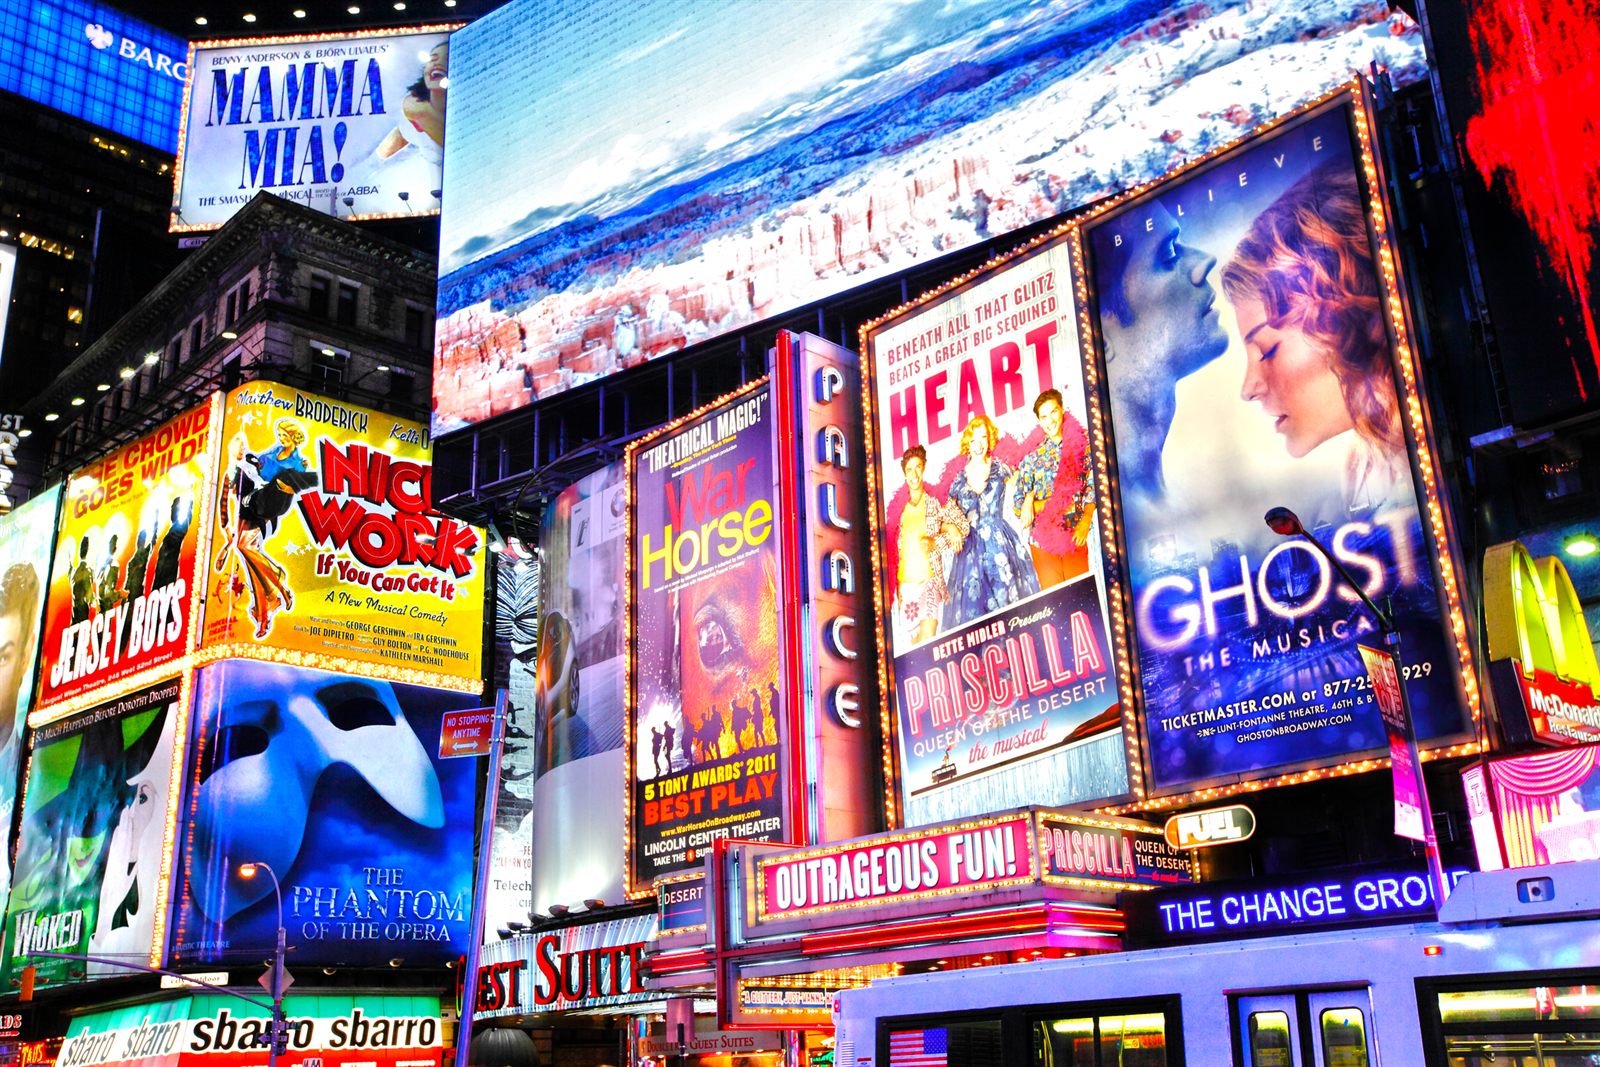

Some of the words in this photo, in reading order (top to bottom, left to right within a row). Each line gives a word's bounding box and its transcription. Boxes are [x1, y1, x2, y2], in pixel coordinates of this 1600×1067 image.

[119, 37, 188, 81] BARC
[212, 55, 242, 66] BENNY
[245, 51, 300, 64] ANDERSSON
[304, 50, 311, 59] &
[205, 58, 386, 127] MAMMA
[239, 121, 348, 189] MIA!
[199, 197, 217, 207] THE
[347, 186, 379, 196] ABBA
[1114, 136, 1323, 247] BELIEVE
[947, 312, 970, 338] ALL
[975, 295, 1008, 324] THAT
[1014, 272, 1054, 306] GLITZ
[889, 360, 921, 385] BEATS
[925, 356, 931, 370] A
[935, 337, 969, 364] GREAT
[973, 327, 993, 346] BIG
[997, 296, 1057, 335] SEQUINED
[0, 413, 24, 431] ST
[236, 390, 294, 411] Matthew
[295, 393, 369, 434] BRODERICK
[389, 423, 420, 445] Kelli
[123, 407, 211, 470] CROWD
[74, 471, 134, 519] GOES
[665, 457, 755, 532] War
[299, 490, 479, 577] WORK
[642, 499, 773, 590] Horse
[815, 366, 862, 728] PALACE
[316, 553, 334, 575] If
[337, 560, 371, 586] You
[372, 572, 405, 592] Can
[407, 574, 438, 594] Get
[441, 582, 455, 600] It
[1138, 510, 1418, 652] GHOST
[325, 591, 335, 602] A
[340, 592, 362, 607] New
[366, 596, 407, 616] Musical
[409, 606, 449, 626] Comedy
[50, 601, 130, 689] JERSEY
[128, 578, 186, 659] BOYS
[309, 627, 321, 636] JOE
[323, 629, 355, 641] DIPIETRO
[373, 637, 385, 646] GUY
[387, 639, 412, 650] BOLTON
[433, 648, 470, 661] WODEHOUSE
[346, 620, 371, 632] GEORGE
[373, 626, 406, 638] GERSHWIN
[414, 632, 424, 641] IRA
[425, 634, 457, 647] GERSHWIN
[932, 638, 965, 662] BETTE
[967, 621, 1006, 648] MIDLER
[1008, 606, 1054, 632] Presents
[1184, 648, 1232, 677] THE
[1252, 614, 1375, 658] MUSICA
[64, 687, 82, 698] Wilson
[121, 667, 136, 677] West
[153, 652, 173, 663] Street
[380, 649, 411, 660] KATHLEEN
[413, 654, 444, 667] MARSHALL
[904, 611, 1107, 738] PRISCILLA
[447, 718, 456, 728] NO
[458, 714, 490, 726] STOPPING
[913, 726, 966, 757] QUEEN
[972, 721, 997, 737] OF
[999, 703, 1033, 727] THE
[1039, 677, 1107, 714] DESERT
[1161, 690, 1297, 732] TICKETMASTER.COM
[1301, 688, 1318, 702] or
[1217, 711, 1286, 734] LUNT-FONTANNE
[1288, 703, 1328, 723] THEATRE,
[1331, 698, 1353, 711] 46TH
[1356, 696, 1363, 706] &
[1236, 714, 1352, 743] GHOSTONBROADWAY.COM
[1548, 718, 1600, 742] Restauran
[452, 728, 481, 739] ANYTIME
[969, 739, 988, 765] the
[992, 718, 1049, 757] musical
[644, 784, 655, 801] 5
[658, 775, 689, 797] TONY
[746, 753, 776, 776] 2011
[644, 790, 706, 826] BEST
[711, 772, 778, 811] PLAY
[644, 836, 686, 856] LINCOLN
[732, 817, 781, 838] THEATER
[660, 809, 761, 838] www.WarHorseOnBroadway.com
[1176, 810, 1242, 844] FUEL
[653, 855, 671, 867] TAKE
[672, 852, 686, 864] THE
[776, 842, 938, 910] OUTRAGEOUS
[950, 826, 1017, 885] FUN!
[1043, 827, 1137, 878] PRISCILLA
[1135, 840, 1165, 855] QUEEN
[1135, 854, 1154, 867] THE
[1156, 857, 1191, 871] DESERT
[363, 867, 404, 886] THE
[494, 880, 532, 891] Telech
[664, 886, 703, 905] DESERT
[291, 886, 465, 922] PHANTOM
[1160, 899, 1215, 931] THE
[1222, 884, 1346, 926] CHANGE
[196, 940, 231, 949] THEATRE
[302, 921, 329, 940] OF
[340, 923, 380, 940] THE
[385, 923, 450, 942] OPERA
[535, 935, 646, 1006] SUITE
[63, 1030, 117, 1067] sbarro
[122, 1019, 182, 1059] sbarro
[329, 1010, 436, 1048] sbarro
[721, 1034, 754, 1049] SUITES
